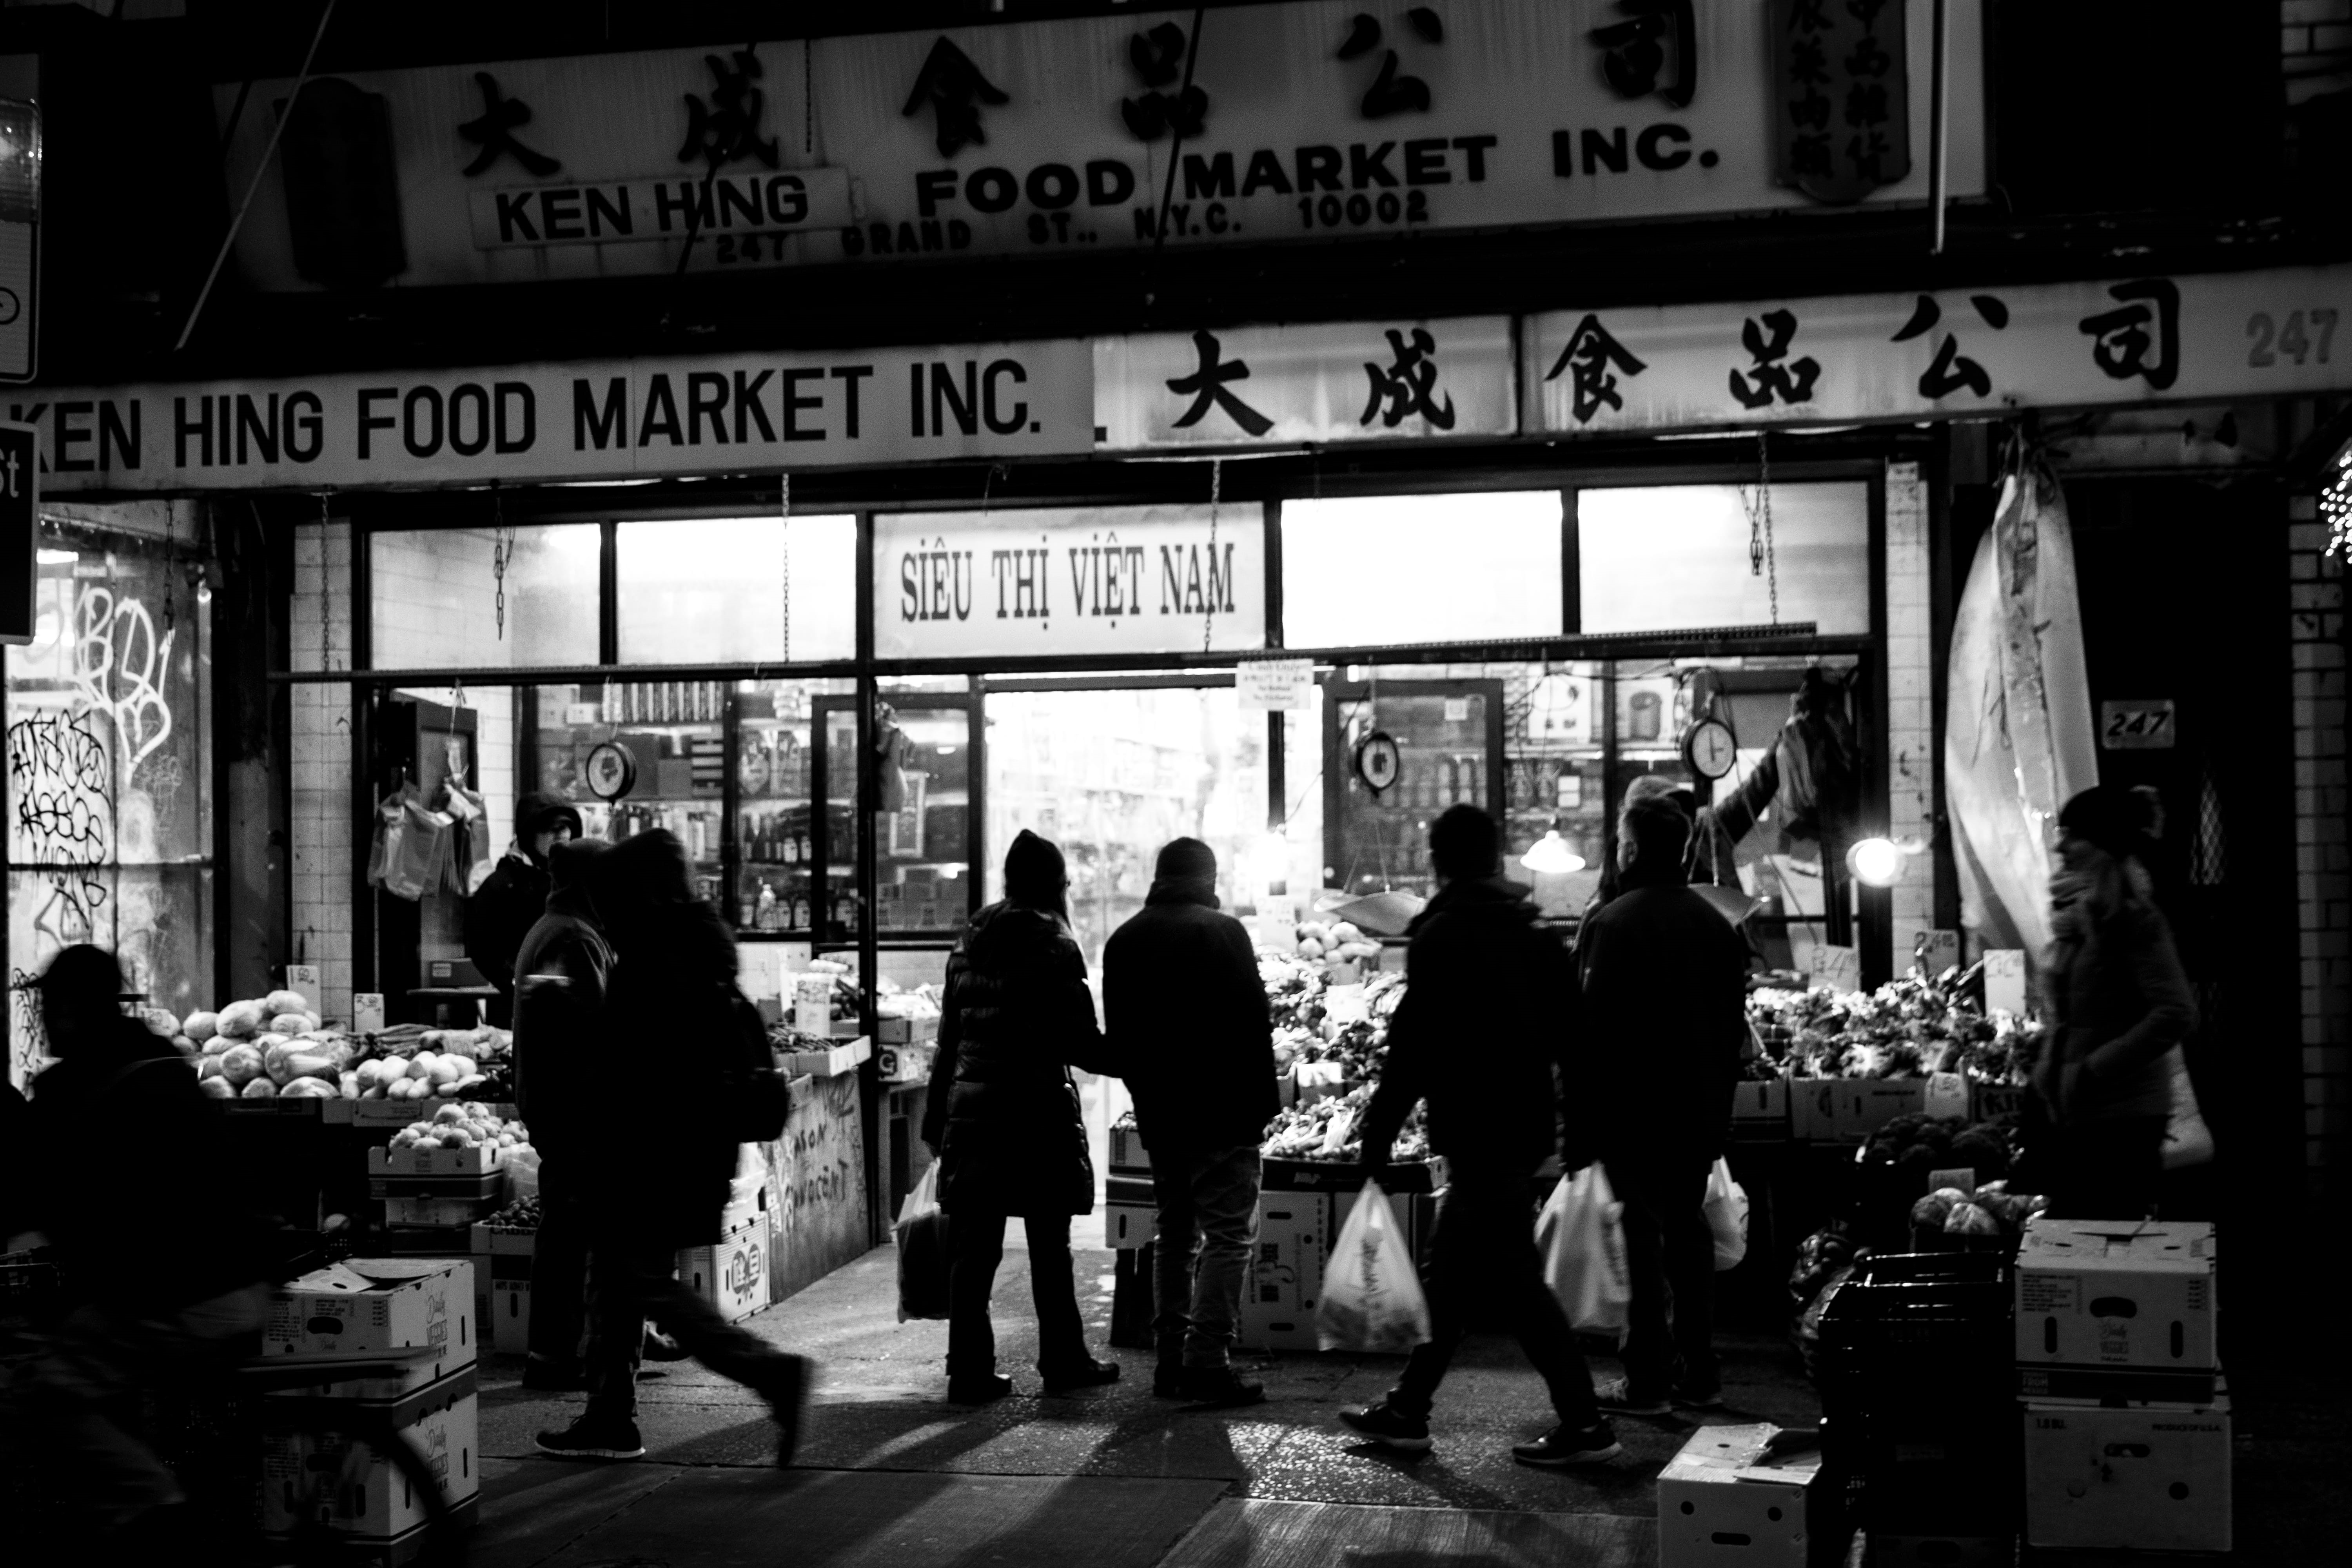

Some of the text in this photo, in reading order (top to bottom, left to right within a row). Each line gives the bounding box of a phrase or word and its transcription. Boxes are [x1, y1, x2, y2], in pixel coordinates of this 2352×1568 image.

[457, 0, 1696, 179] 大成食品公司
[496, 123, 1719, 242] KEN HING FOOD MARKET INC.
[841, 220, 971, 257] GRAND
[1298, 190, 1428, 230] 10002
[1169, 278, 2178, 437] 大成食品公司
[2247, 307, 2339, 367] 247
[174, 390, 323, 468] HING
[358, 381, 536, 460] FOOD
[573, 365, 874, 451] MARKET
[911, 358, 1041, 438] INC.
[1160, 543, 1235, 615] NAM
[2107, 710, 2169, 738] 247
